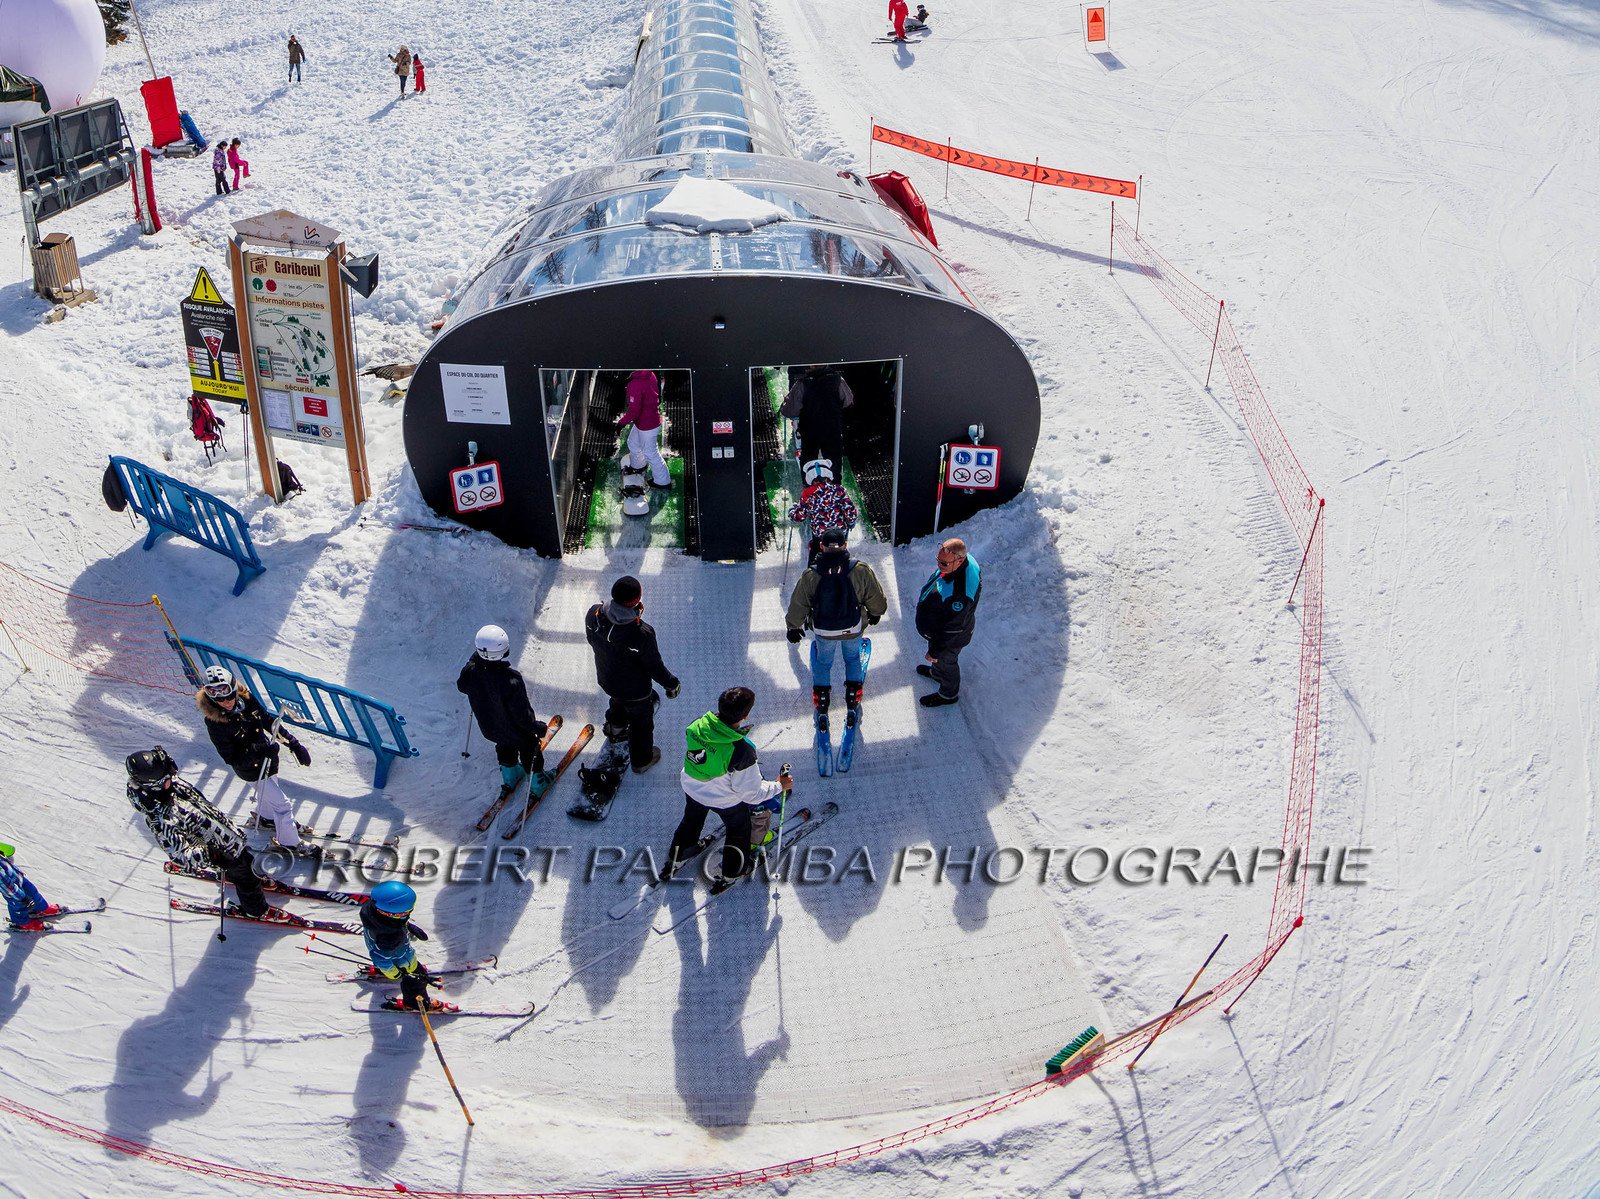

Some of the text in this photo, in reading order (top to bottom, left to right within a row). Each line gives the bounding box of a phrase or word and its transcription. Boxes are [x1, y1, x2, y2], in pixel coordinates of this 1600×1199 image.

[274, 261, 321, 277] Garibeuil
[183, 302, 235, 316] RISQUE AVALANCHE
[255, 295, 325, 310] Informations pistes
[190, 311, 216, 321] Avalanche
[200, 380, 240, 392] AUJOURD'HUI
[284, 383, 315, 394] sécurité
